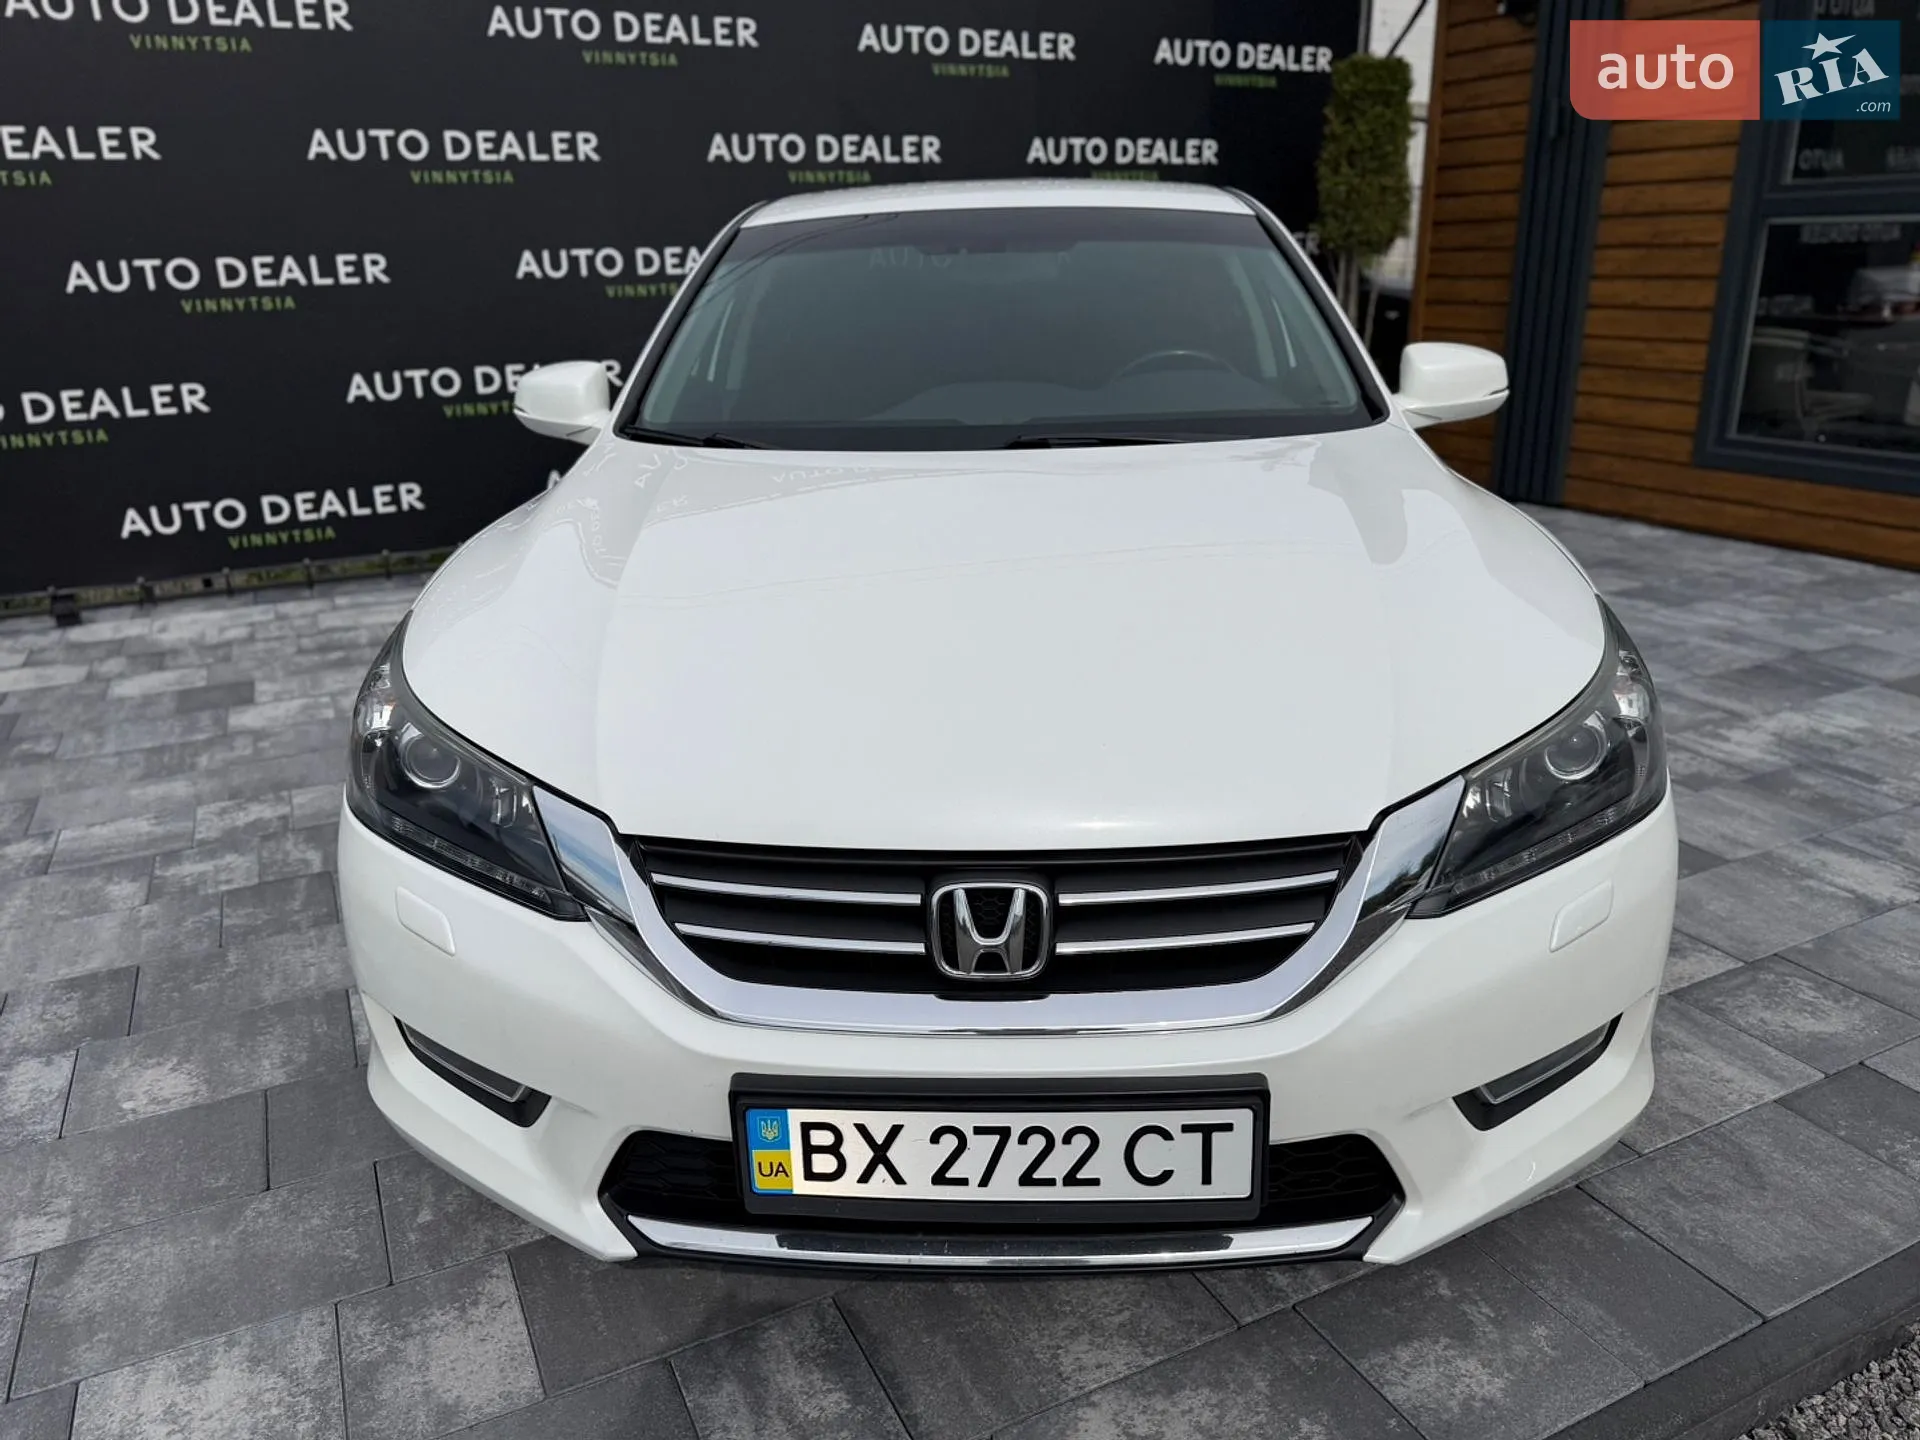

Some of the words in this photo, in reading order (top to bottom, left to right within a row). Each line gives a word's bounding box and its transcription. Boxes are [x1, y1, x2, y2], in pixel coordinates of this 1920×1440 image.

[167, 0, 353, 31] DEALER
[487, 5, 601, 42] AUTO
[613, 10, 759, 48] DEALER
[129, 34, 253, 53] VINNYTSIA
[582, 50, 678, 67] VINNYTSIA
[857, 23, 950, 56] AUTO
[958, 27, 1076, 61] DEALER
[1153, 37, 1231, 68] AUTO
[1236, 41, 1333, 73] DEALER
[0, 125, 162, 161] EALER
[307, 128, 430, 162] AUTO
[443, 129, 601, 162] DEALER
[707, 133, 806, 163] AUTO
[815, 133, 942, 164] DEALER
[1026, 136, 1108, 165] AUTO
[1114, 137, 1219, 165] DEALER
[410, 169, 515, 185] VINNYTSIA
[65, 257, 201, 294] AUTO
[215, 253, 391, 289] DEALER
[516, 247, 624, 280] AUTO
[181, 295, 296, 314] VINNYTSIA
[346, 367, 462, 404] AUTO
[20, 382, 211, 424] DEALER
[120, 498, 247, 539] AUTO
[260, 482, 425, 521] DEALER
[227, 526, 336, 550] VINNYTSIA
[758, 1161, 790, 1178] UA
[800, 1121, 907, 1186] BX
[929, 1125, 1101, 1188] 2722
[1123, 1122, 1235, 1187] CT
